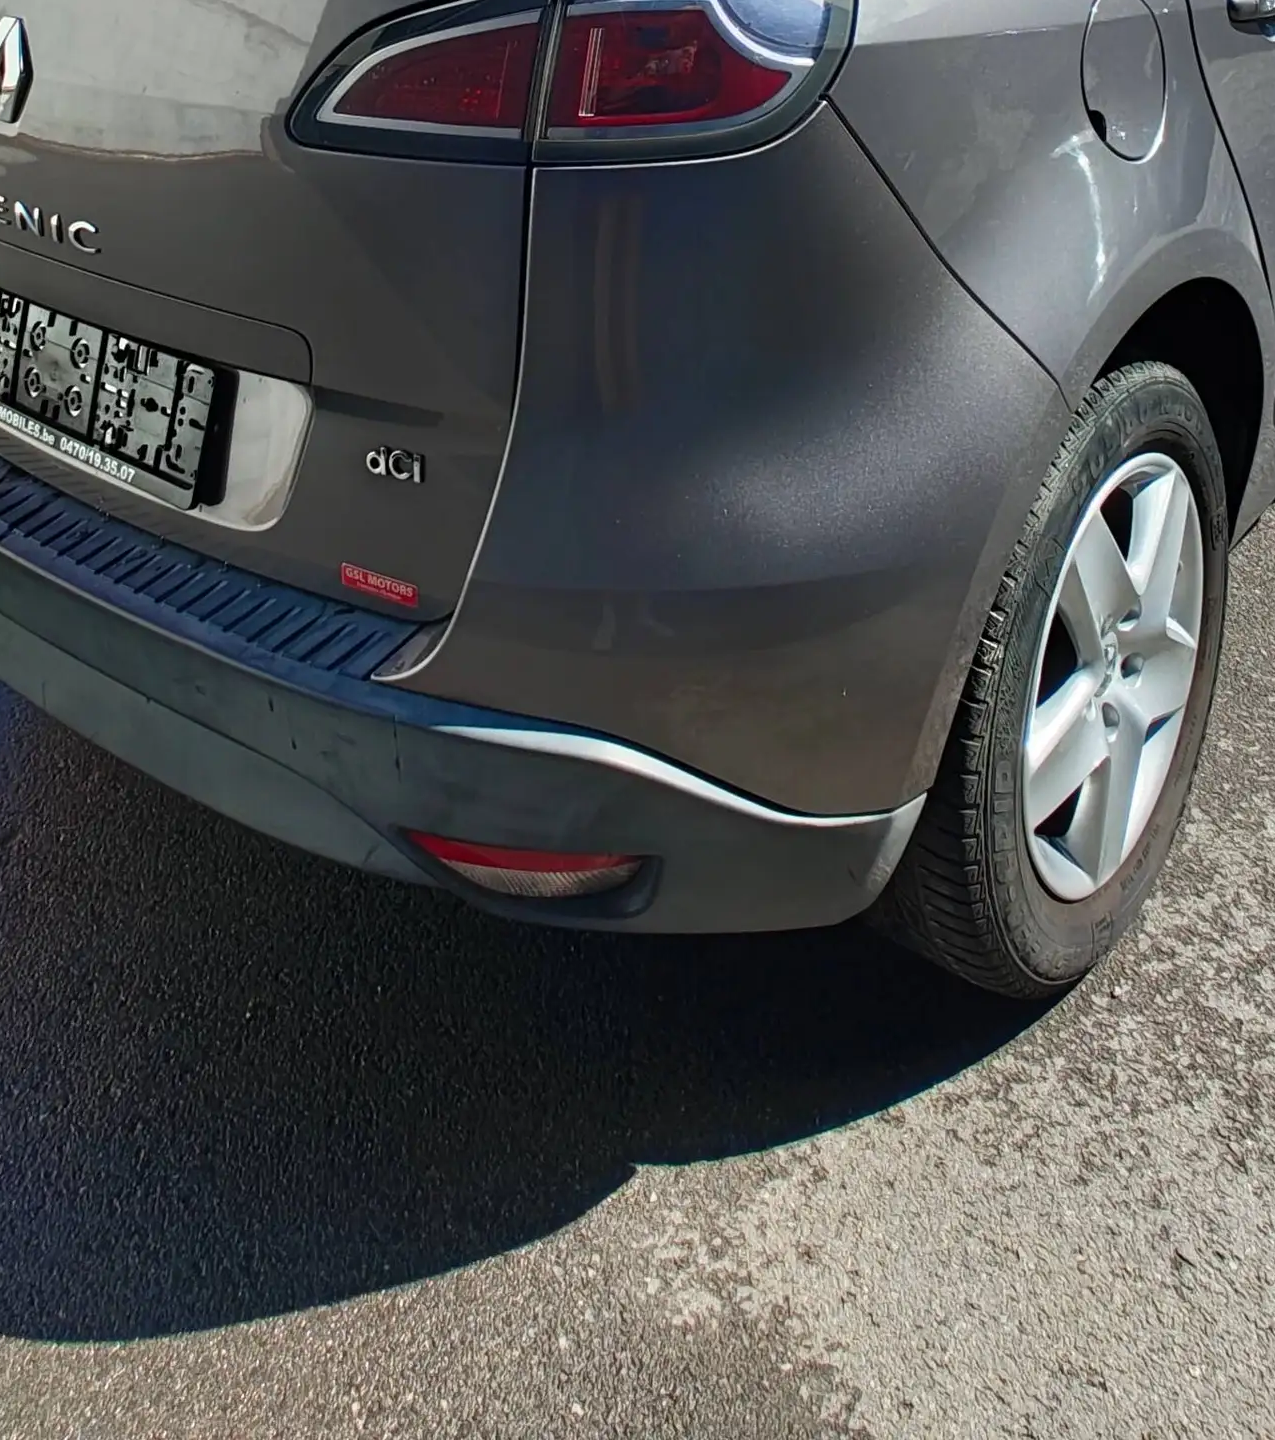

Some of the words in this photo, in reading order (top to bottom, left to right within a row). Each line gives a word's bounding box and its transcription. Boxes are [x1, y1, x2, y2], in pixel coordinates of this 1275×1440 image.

[59, 436, 136, 484] 0470/19.35.07
[345, 567, 366, 583] GSL
[367, 573, 414, 598] MOTORS
